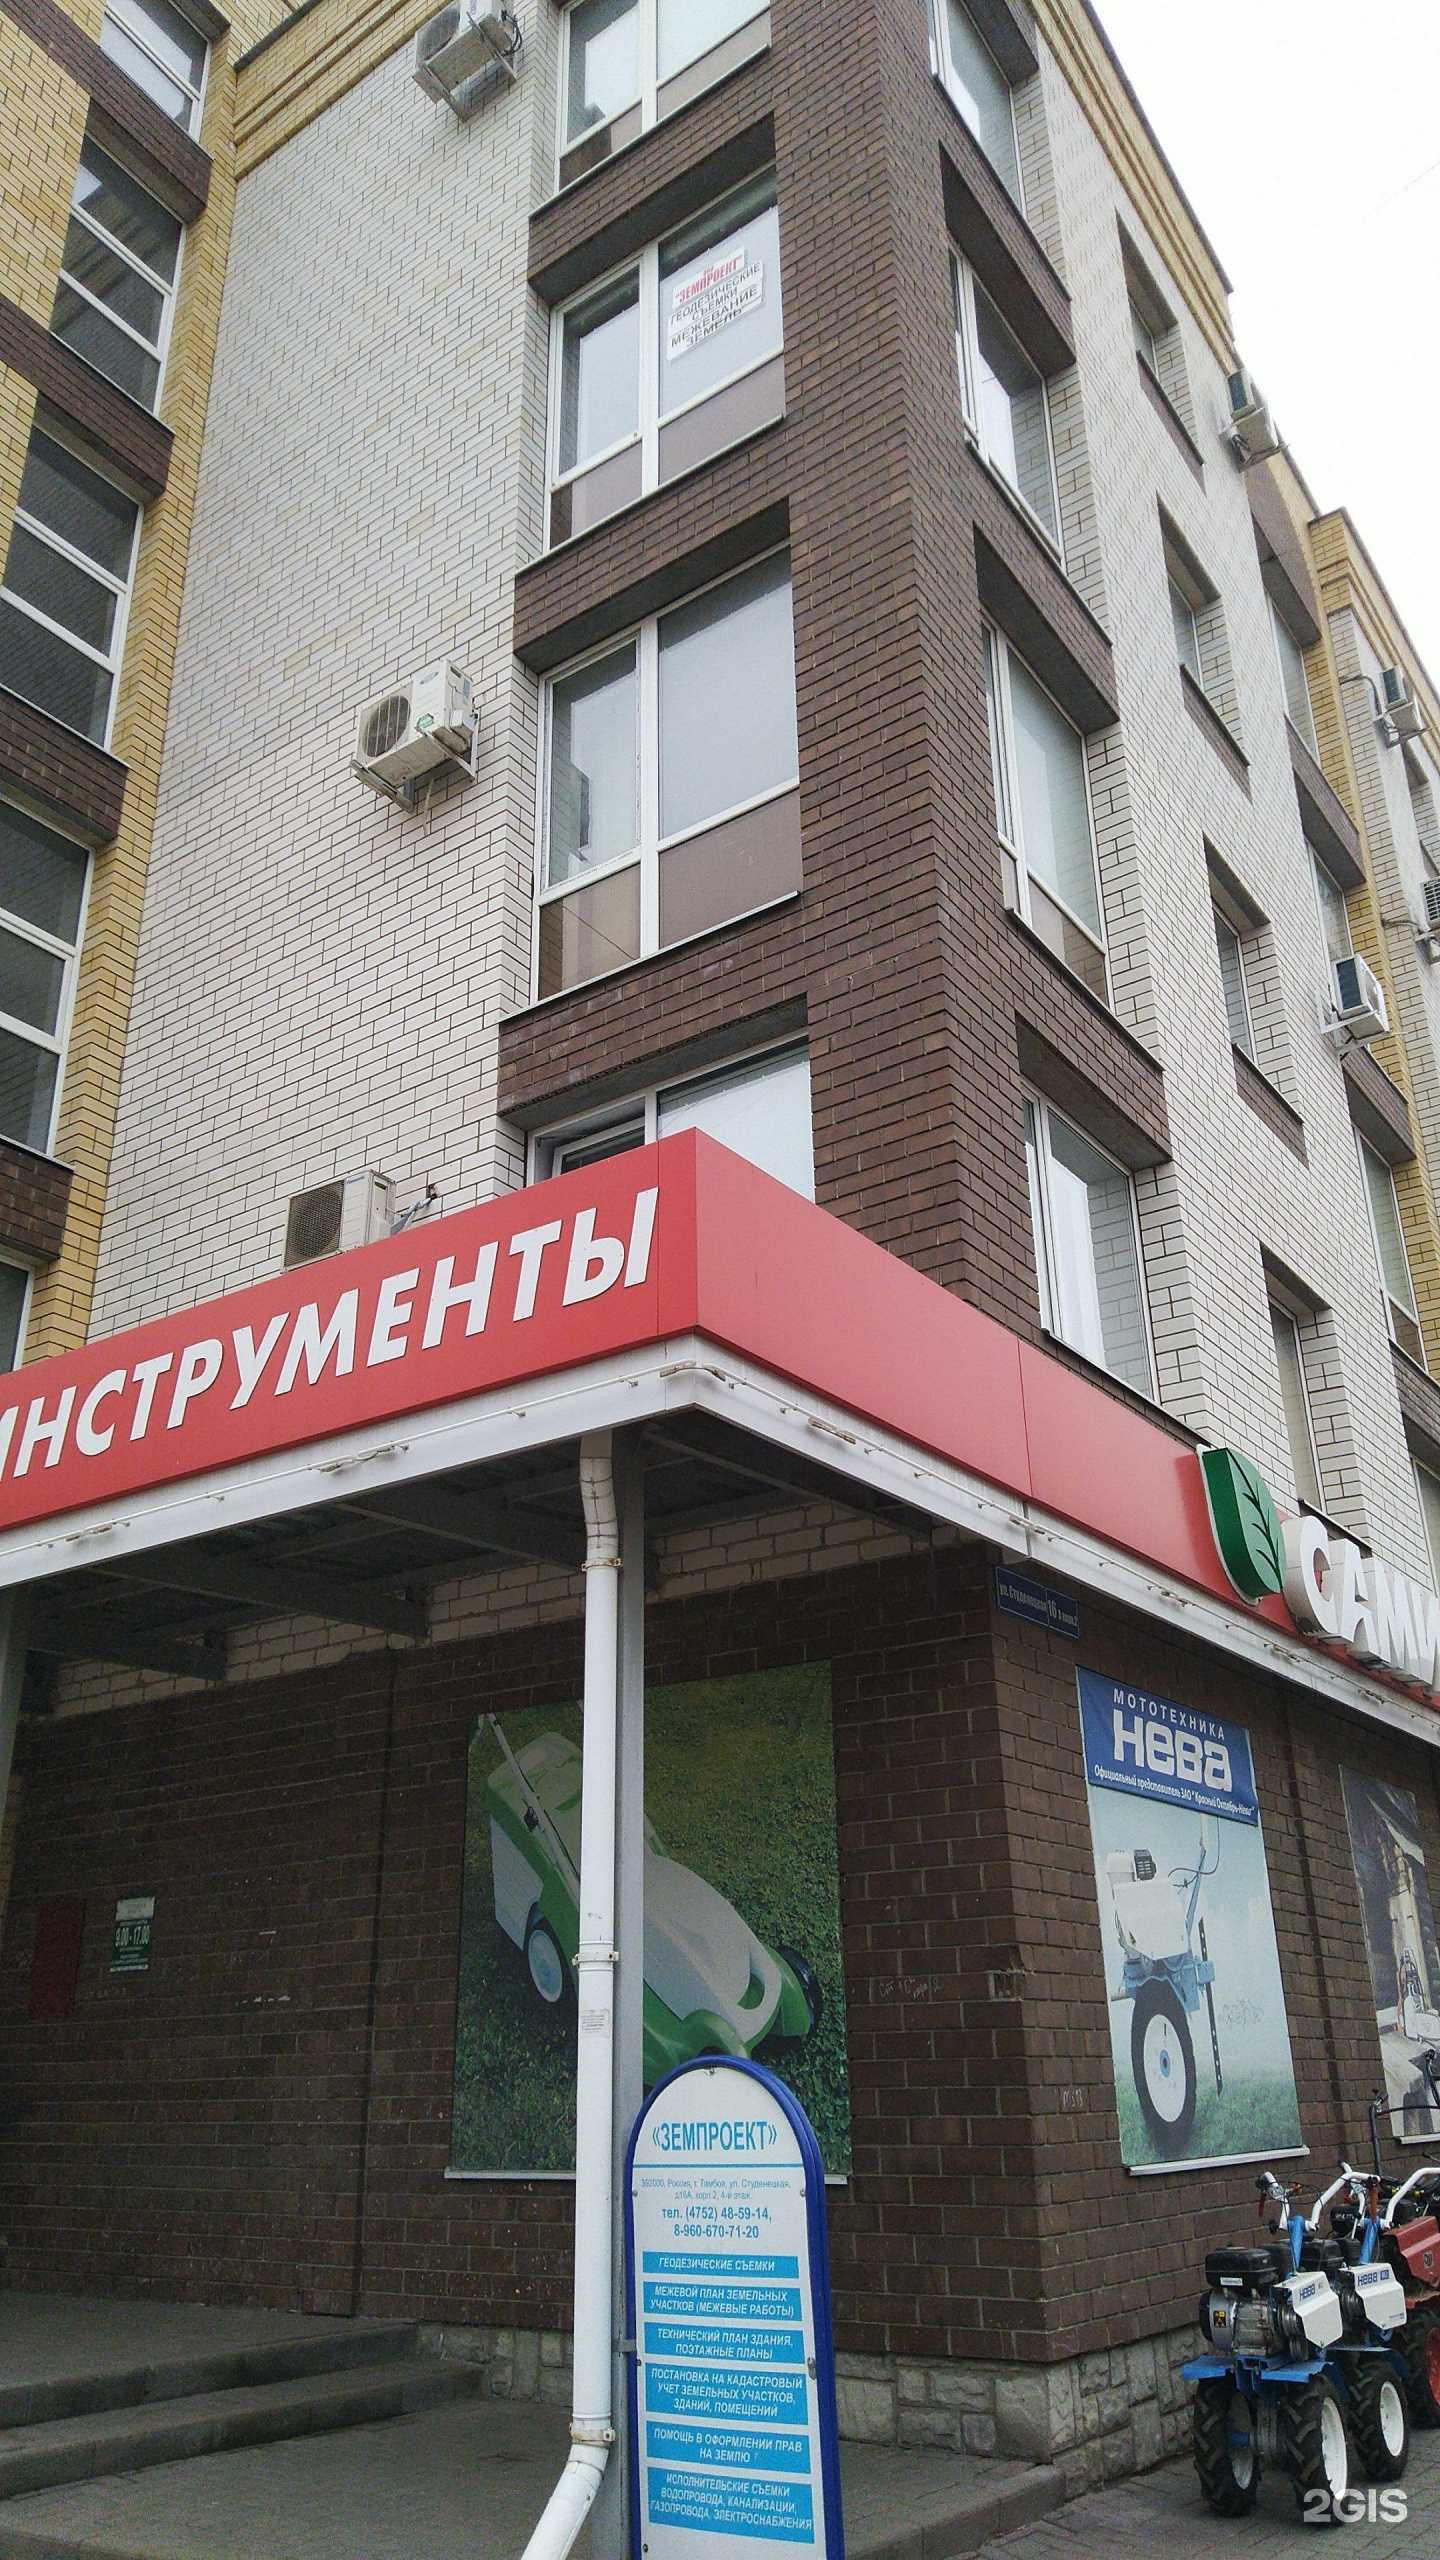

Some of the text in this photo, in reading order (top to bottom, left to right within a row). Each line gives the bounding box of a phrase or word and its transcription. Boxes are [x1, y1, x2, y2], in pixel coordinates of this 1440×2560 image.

[671, 262, 760, 325] ГЕОДЕЗИЧЕСКИЕ
[671, 285, 758, 348] МЕЖЕВАНИЕ
[1047, 1599, 1057, 1618] 16
[1114, 1688, 1225, 1740] МОТОТЕХНИКА
[1094, 1764, 1137, 1786] Официальный
[652, 2121, 777, 2151] «ЗЕМПРОЕКТ»
[662, 2206, 772, 2223] тел. (4752) 48-59-14,
[673, 2224, 759, 2239] 8-960-670-71-20
[659, 2257, 775, 2271] ГЕОДЕЗИЧЕСКИЕ СЪЕМКИ
[655, 2285, 788, 2302] МЕЖЕВОЙ ПЛАН ЗЕМЕЛЬНЫХ
[650, 2299, 794, 2318] УЧАСТКОВ (МЕЖЕВЫЕ РАБОТЫ)
[657, 2327, 794, 2347] ТЕХНИЧЕСКИЙ ПЛАН ЗДАНИЯ,
[675, 2344, 773, 2360] ПОЭТАЖНЫЕ ПЛАНЫ
[651, 2368, 803, 2390] ПОСТАНОВКА НА КАДАСТРОВЫЙ
[657, 2383, 796, 2404] УЧЕТ ЗЕМЕЛЬНЫХ УЧАСТКОВ,
[673, 2397, 778, 2417] ЗДАНИЙ, ПОМЕЩЕНИЙ
[654, 2428, 802, 2453] ПОМОЩЬ В ОФОРМЛЕНИИ ПРАВ
[700, 2448, 751, 2463] НА ЗЕМЛЮ
[666, 2473, 790, 2497] ИСПОЛНИТЕЛЬСКИЕ СЪЕМКИ
[661, 2487, 797, 2515] ВОДОПРОВОДА, КАНАЛИЗАЦИИ,
[713, 2509, 812, 2529] ЭЛЕКТРОСНАБЖЕНИЯ
